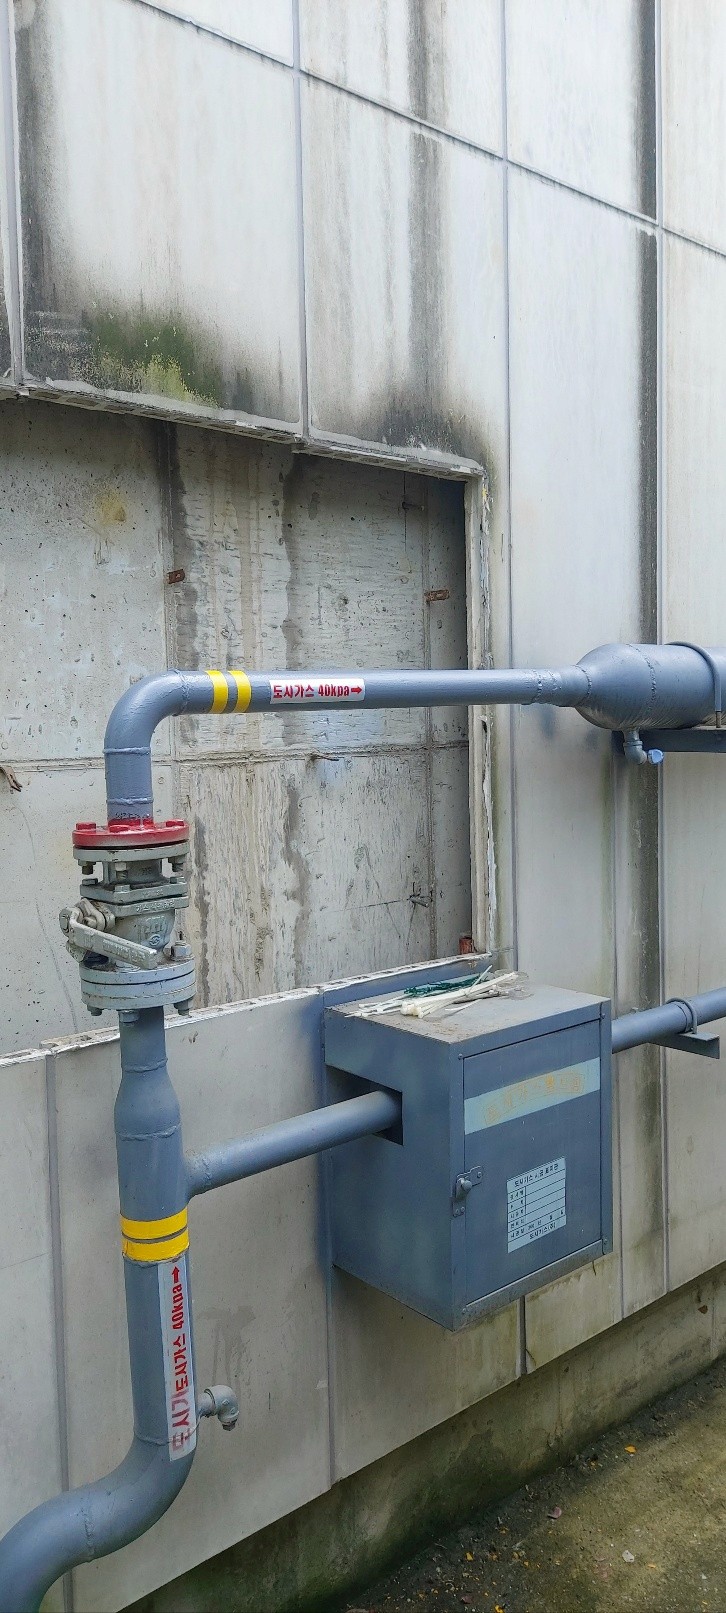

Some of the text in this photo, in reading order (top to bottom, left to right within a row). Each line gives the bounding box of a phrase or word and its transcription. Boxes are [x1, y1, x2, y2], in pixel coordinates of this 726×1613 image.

[273, 683, 349, 698] 도시가스 40kpa
[172, 1283, 185, 1329] 40kpa
[173, 1333, 188, 1392] 도시가스
